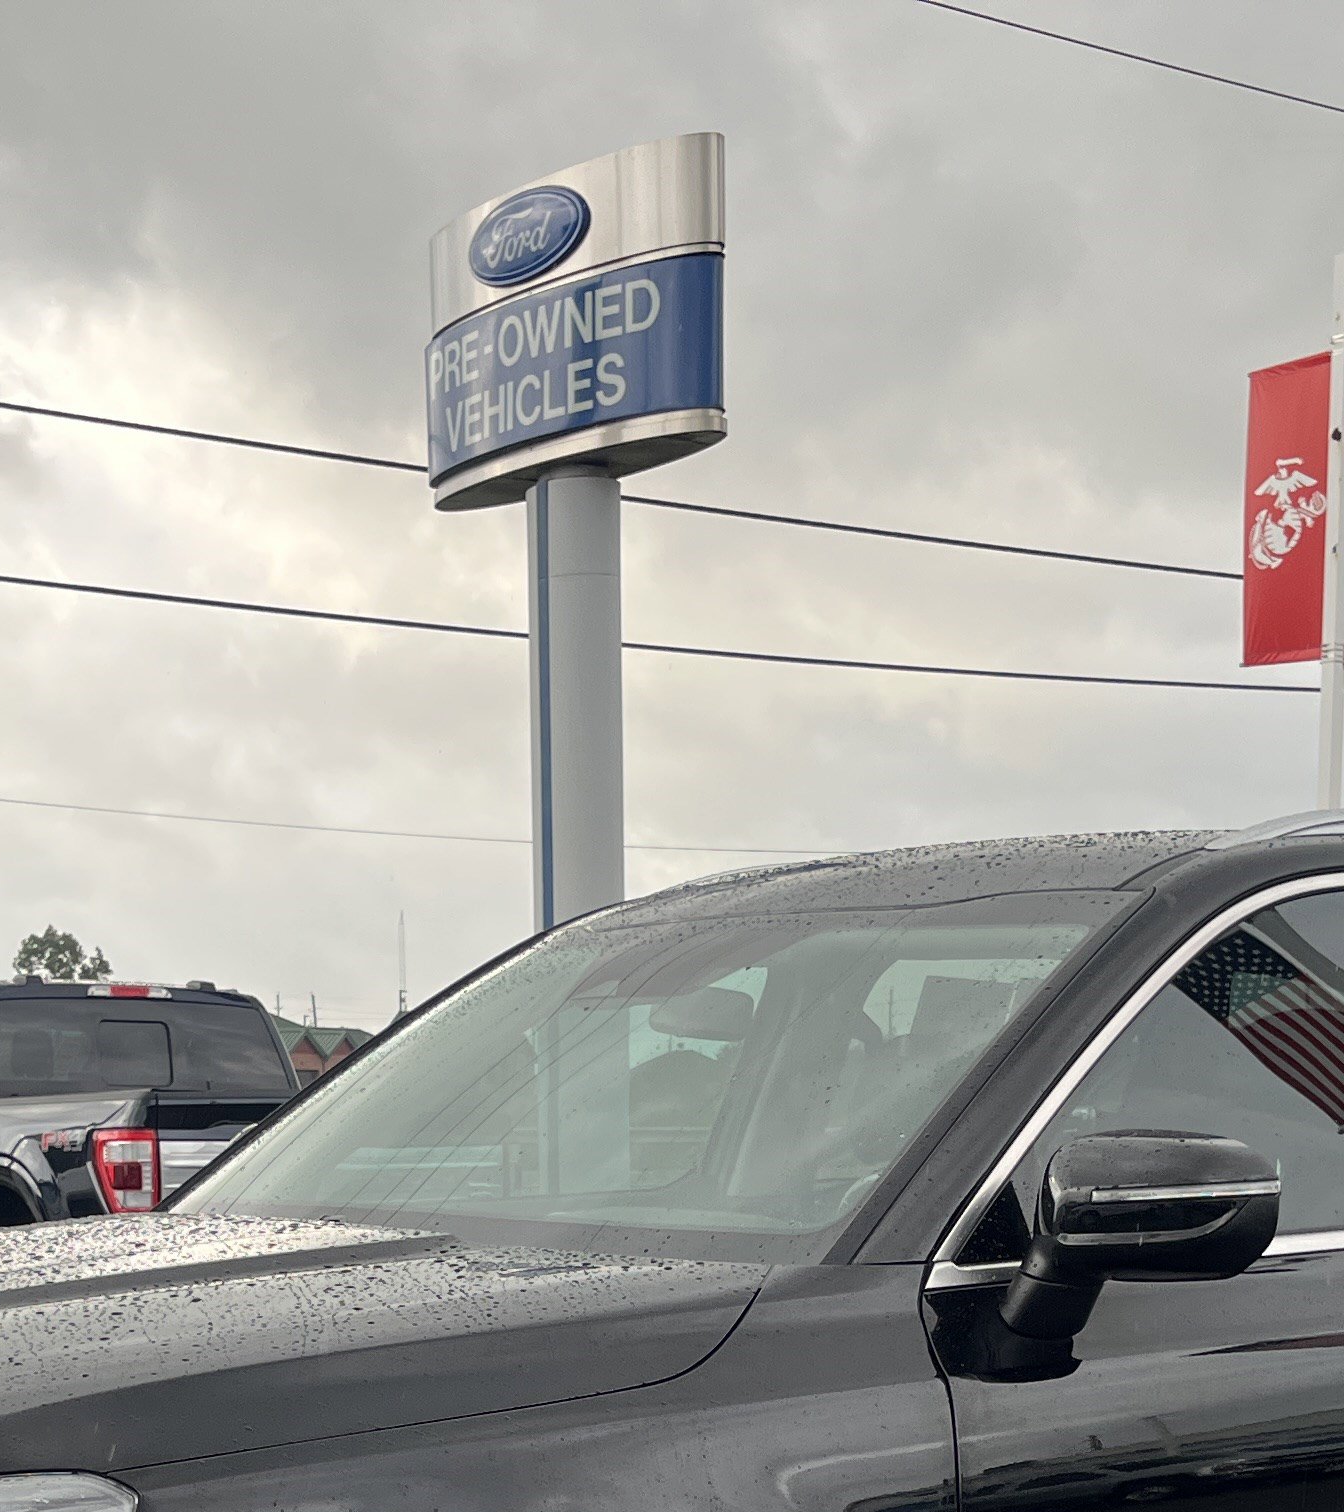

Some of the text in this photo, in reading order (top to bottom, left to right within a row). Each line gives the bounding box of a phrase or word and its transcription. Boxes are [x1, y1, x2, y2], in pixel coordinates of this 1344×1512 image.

[482, 206, 552, 268] Ford
[429, 279, 661, 400] PRE-OWNED
[445, 352, 627, 453] VEHICLES
